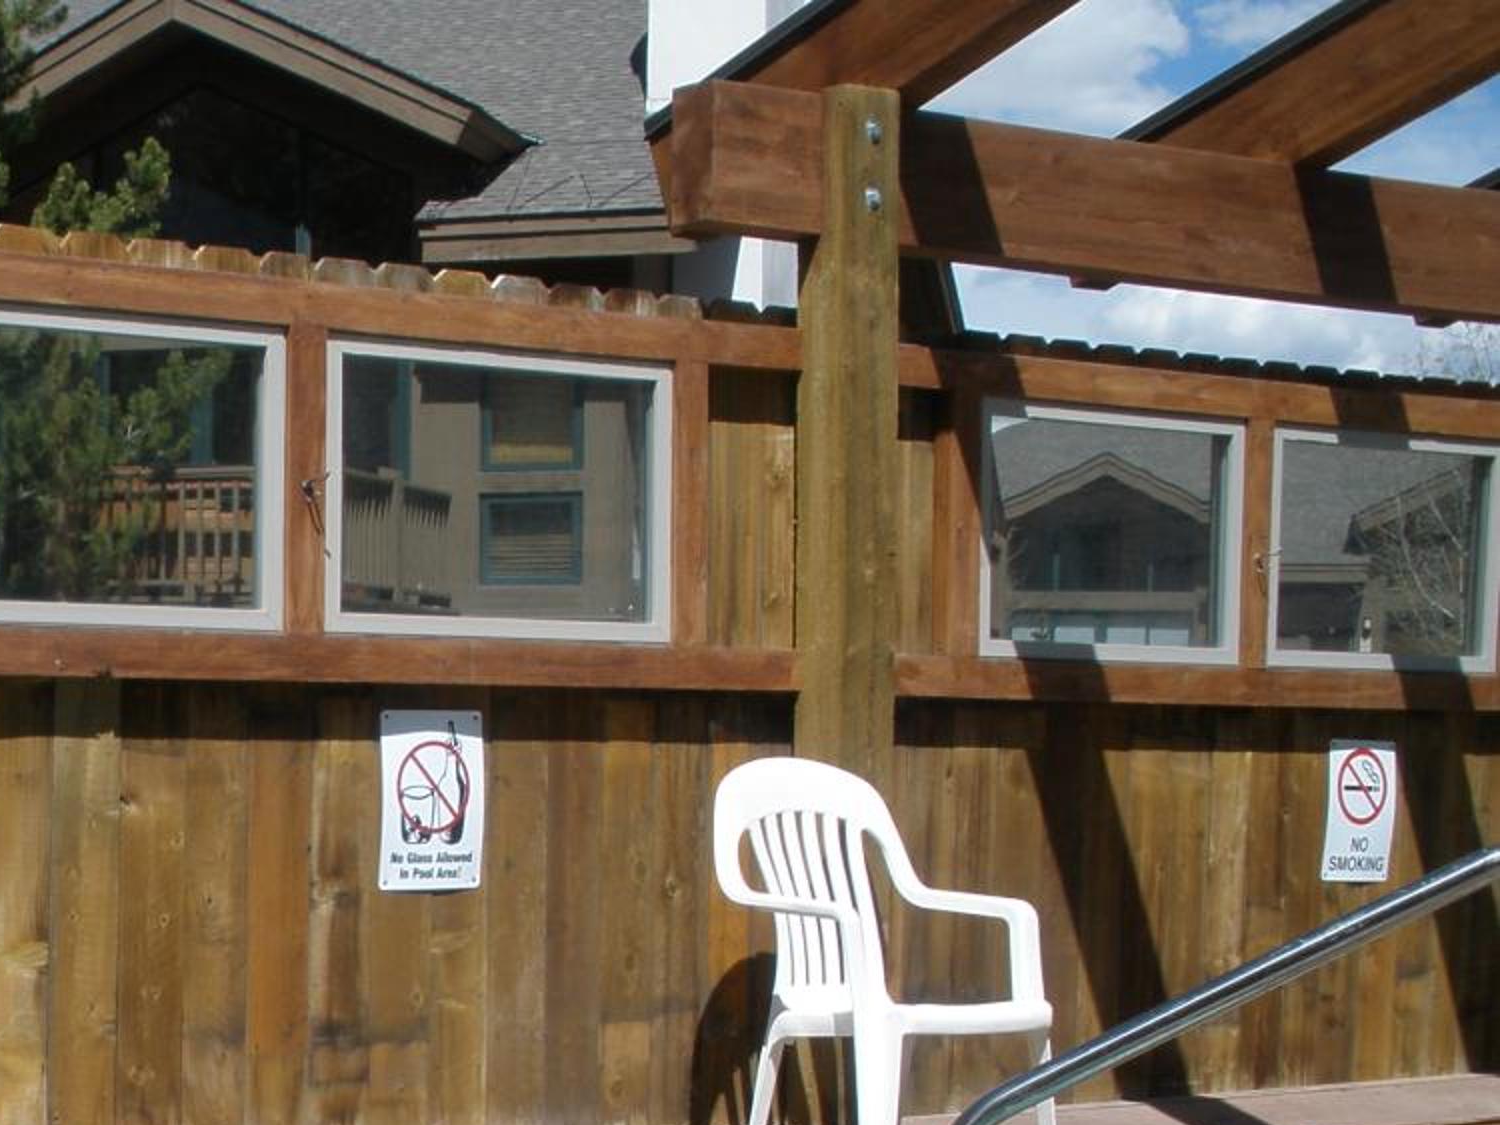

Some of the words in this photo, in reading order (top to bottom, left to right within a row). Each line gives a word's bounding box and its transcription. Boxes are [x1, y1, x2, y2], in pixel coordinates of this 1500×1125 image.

[1350, 836, 1369, 853] NO
[390, 852, 404, 864] No
[407, 851, 433, 864] Glass
[436, 851, 473, 863] Allowed
[1328, 855, 1385, 873] SMOKING
[413, 867, 434, 878] Pool
